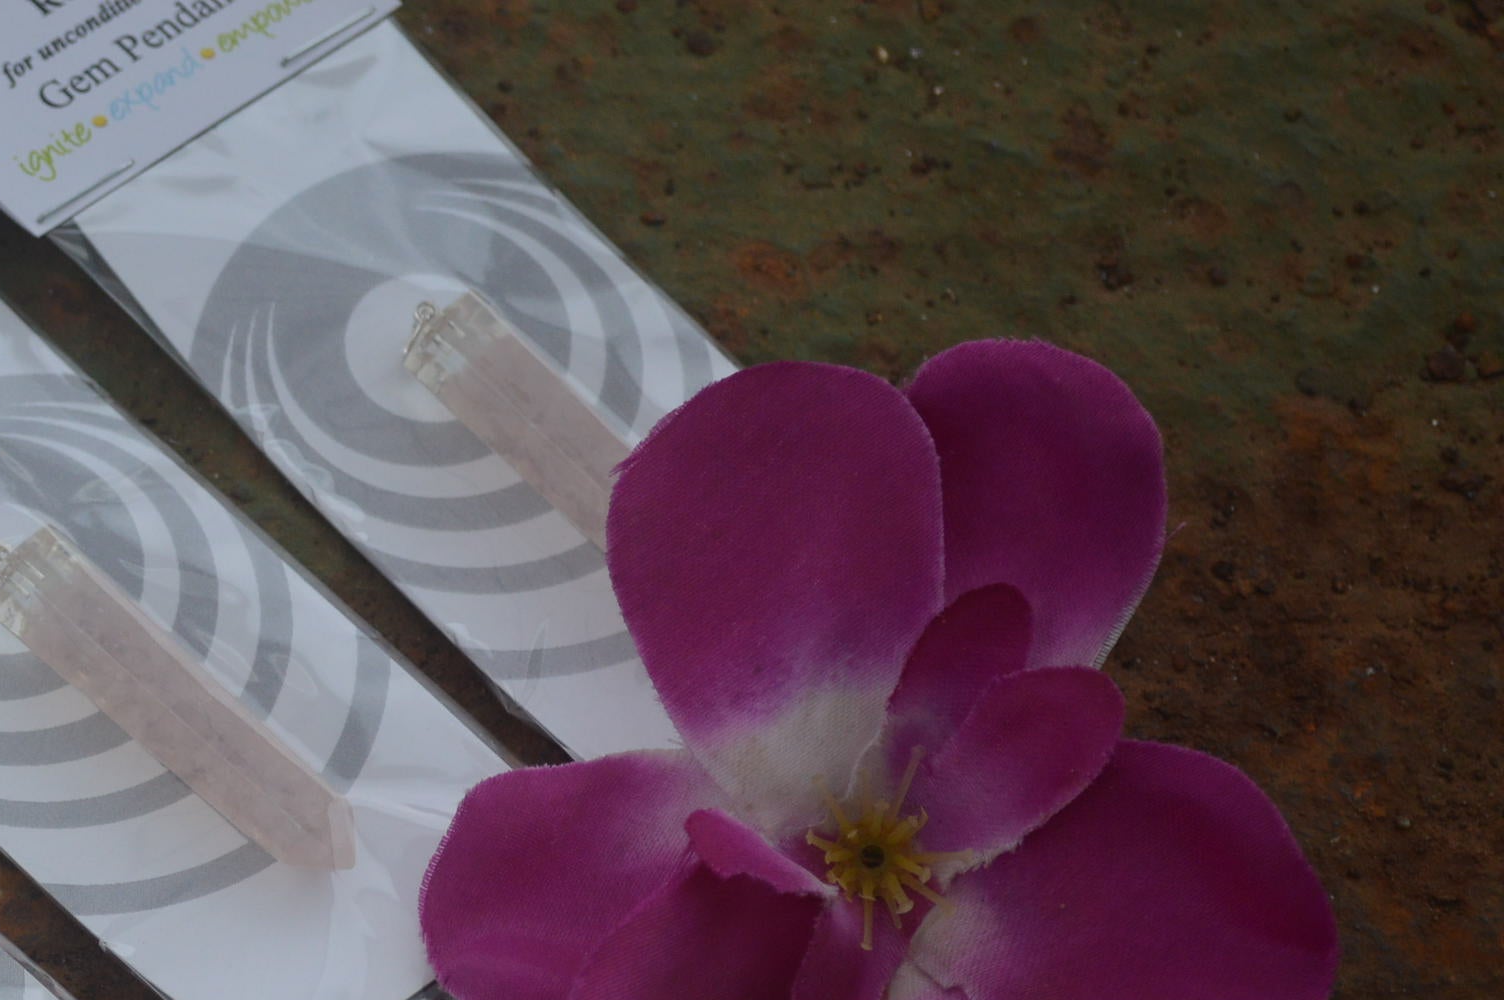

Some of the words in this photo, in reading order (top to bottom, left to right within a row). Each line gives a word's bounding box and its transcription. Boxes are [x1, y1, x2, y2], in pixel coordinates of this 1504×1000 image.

[2, 61, 33, 88] for
[38, 56, 122, 108] Gem
[14, 121, 92, 181] ignite
[109, 47, 204, 121] expand
